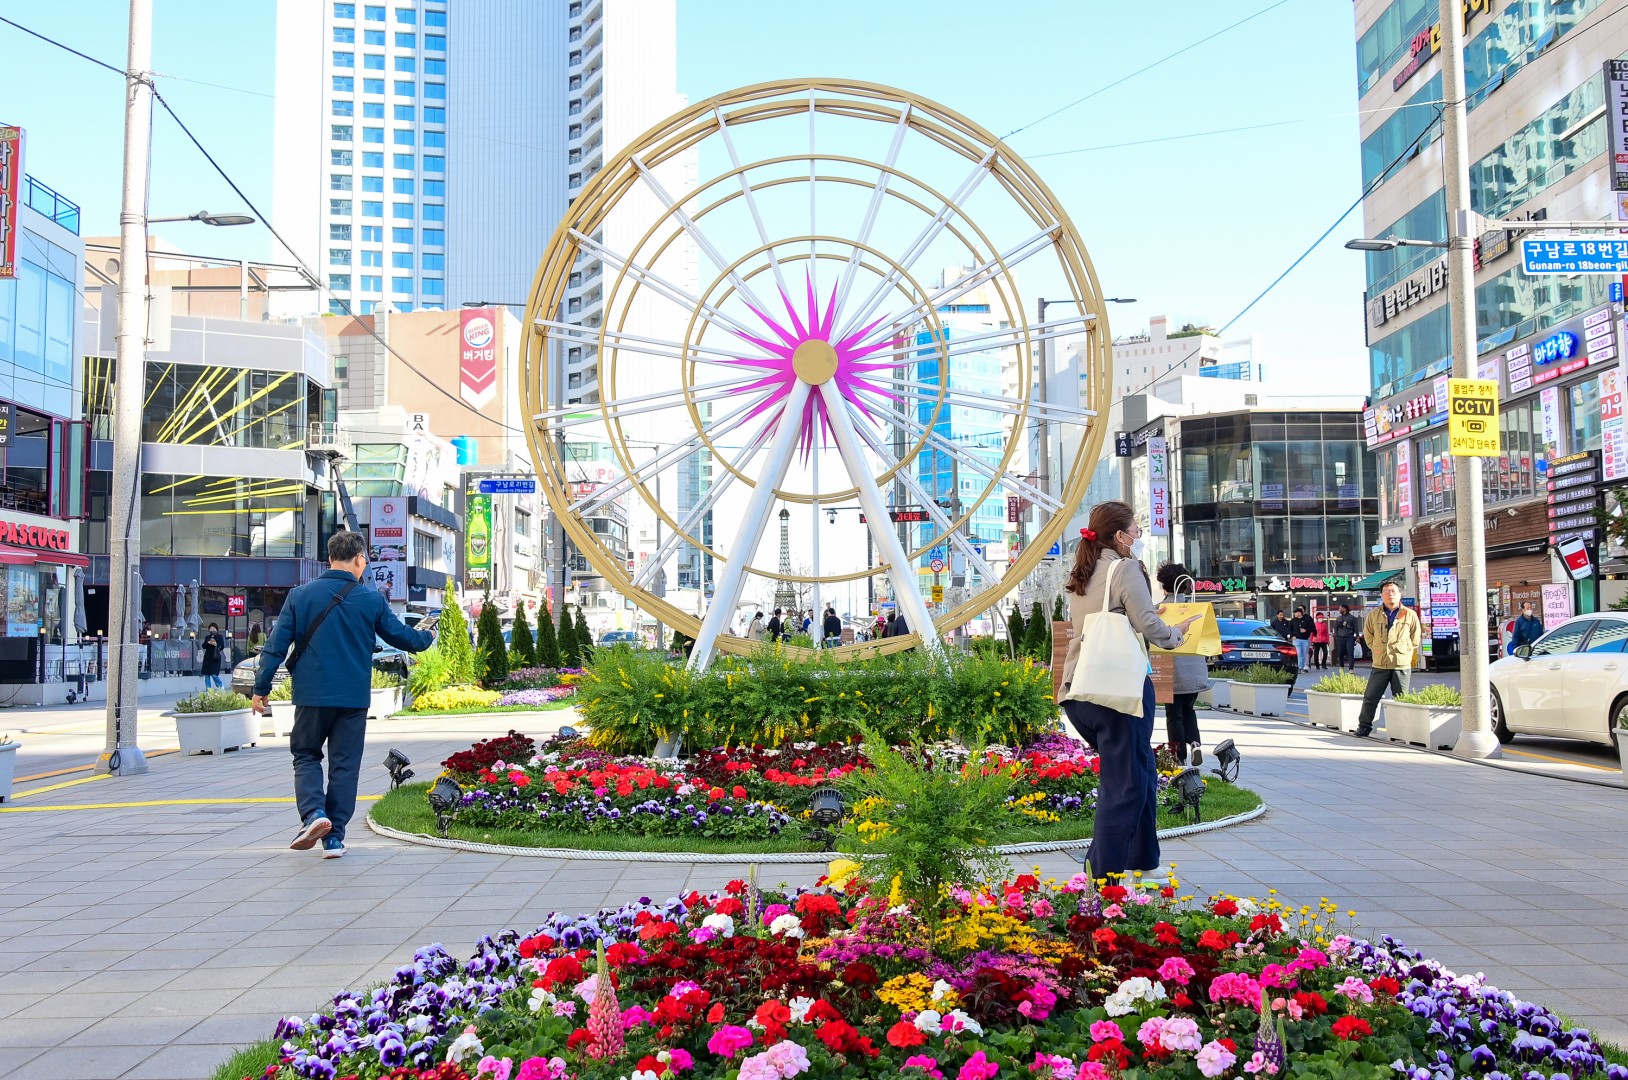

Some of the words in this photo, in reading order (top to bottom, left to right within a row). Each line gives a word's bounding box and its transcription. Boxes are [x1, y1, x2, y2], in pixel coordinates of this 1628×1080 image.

[1410, 25, 1431, 58] 50%
[1528, 242, 1577, 258] 구남로
[1529, 261, 1575, 270] Gunam-ro
[1578, 261, 1628, 271] 18beon-gil
[468, 324, 489, 334] BURGER
[470, 328, 490, 341] KING
[1534, 333, 1573, 362] 바다향
[464, 349, 494, 361] 버거킹
[1455, 399, 1491, 414] CCTV
[1601, 395, 1622, 416] 미우
[1119, 433, 1127, 454] BAR
[1453, 438, 1475, 449] 24시간
[1477, 439, 1497, 450] 단속중
[1153, 488, 1164, 528] 낙곱새
[0, 521, 70, 550] PASCUCCI
[1389, 538, 1401, 546] GS
[1390, 545, 1401, 553] 25
[469, 571, 488, 580] TERRA
[228, 597, 244, 606] 24h
